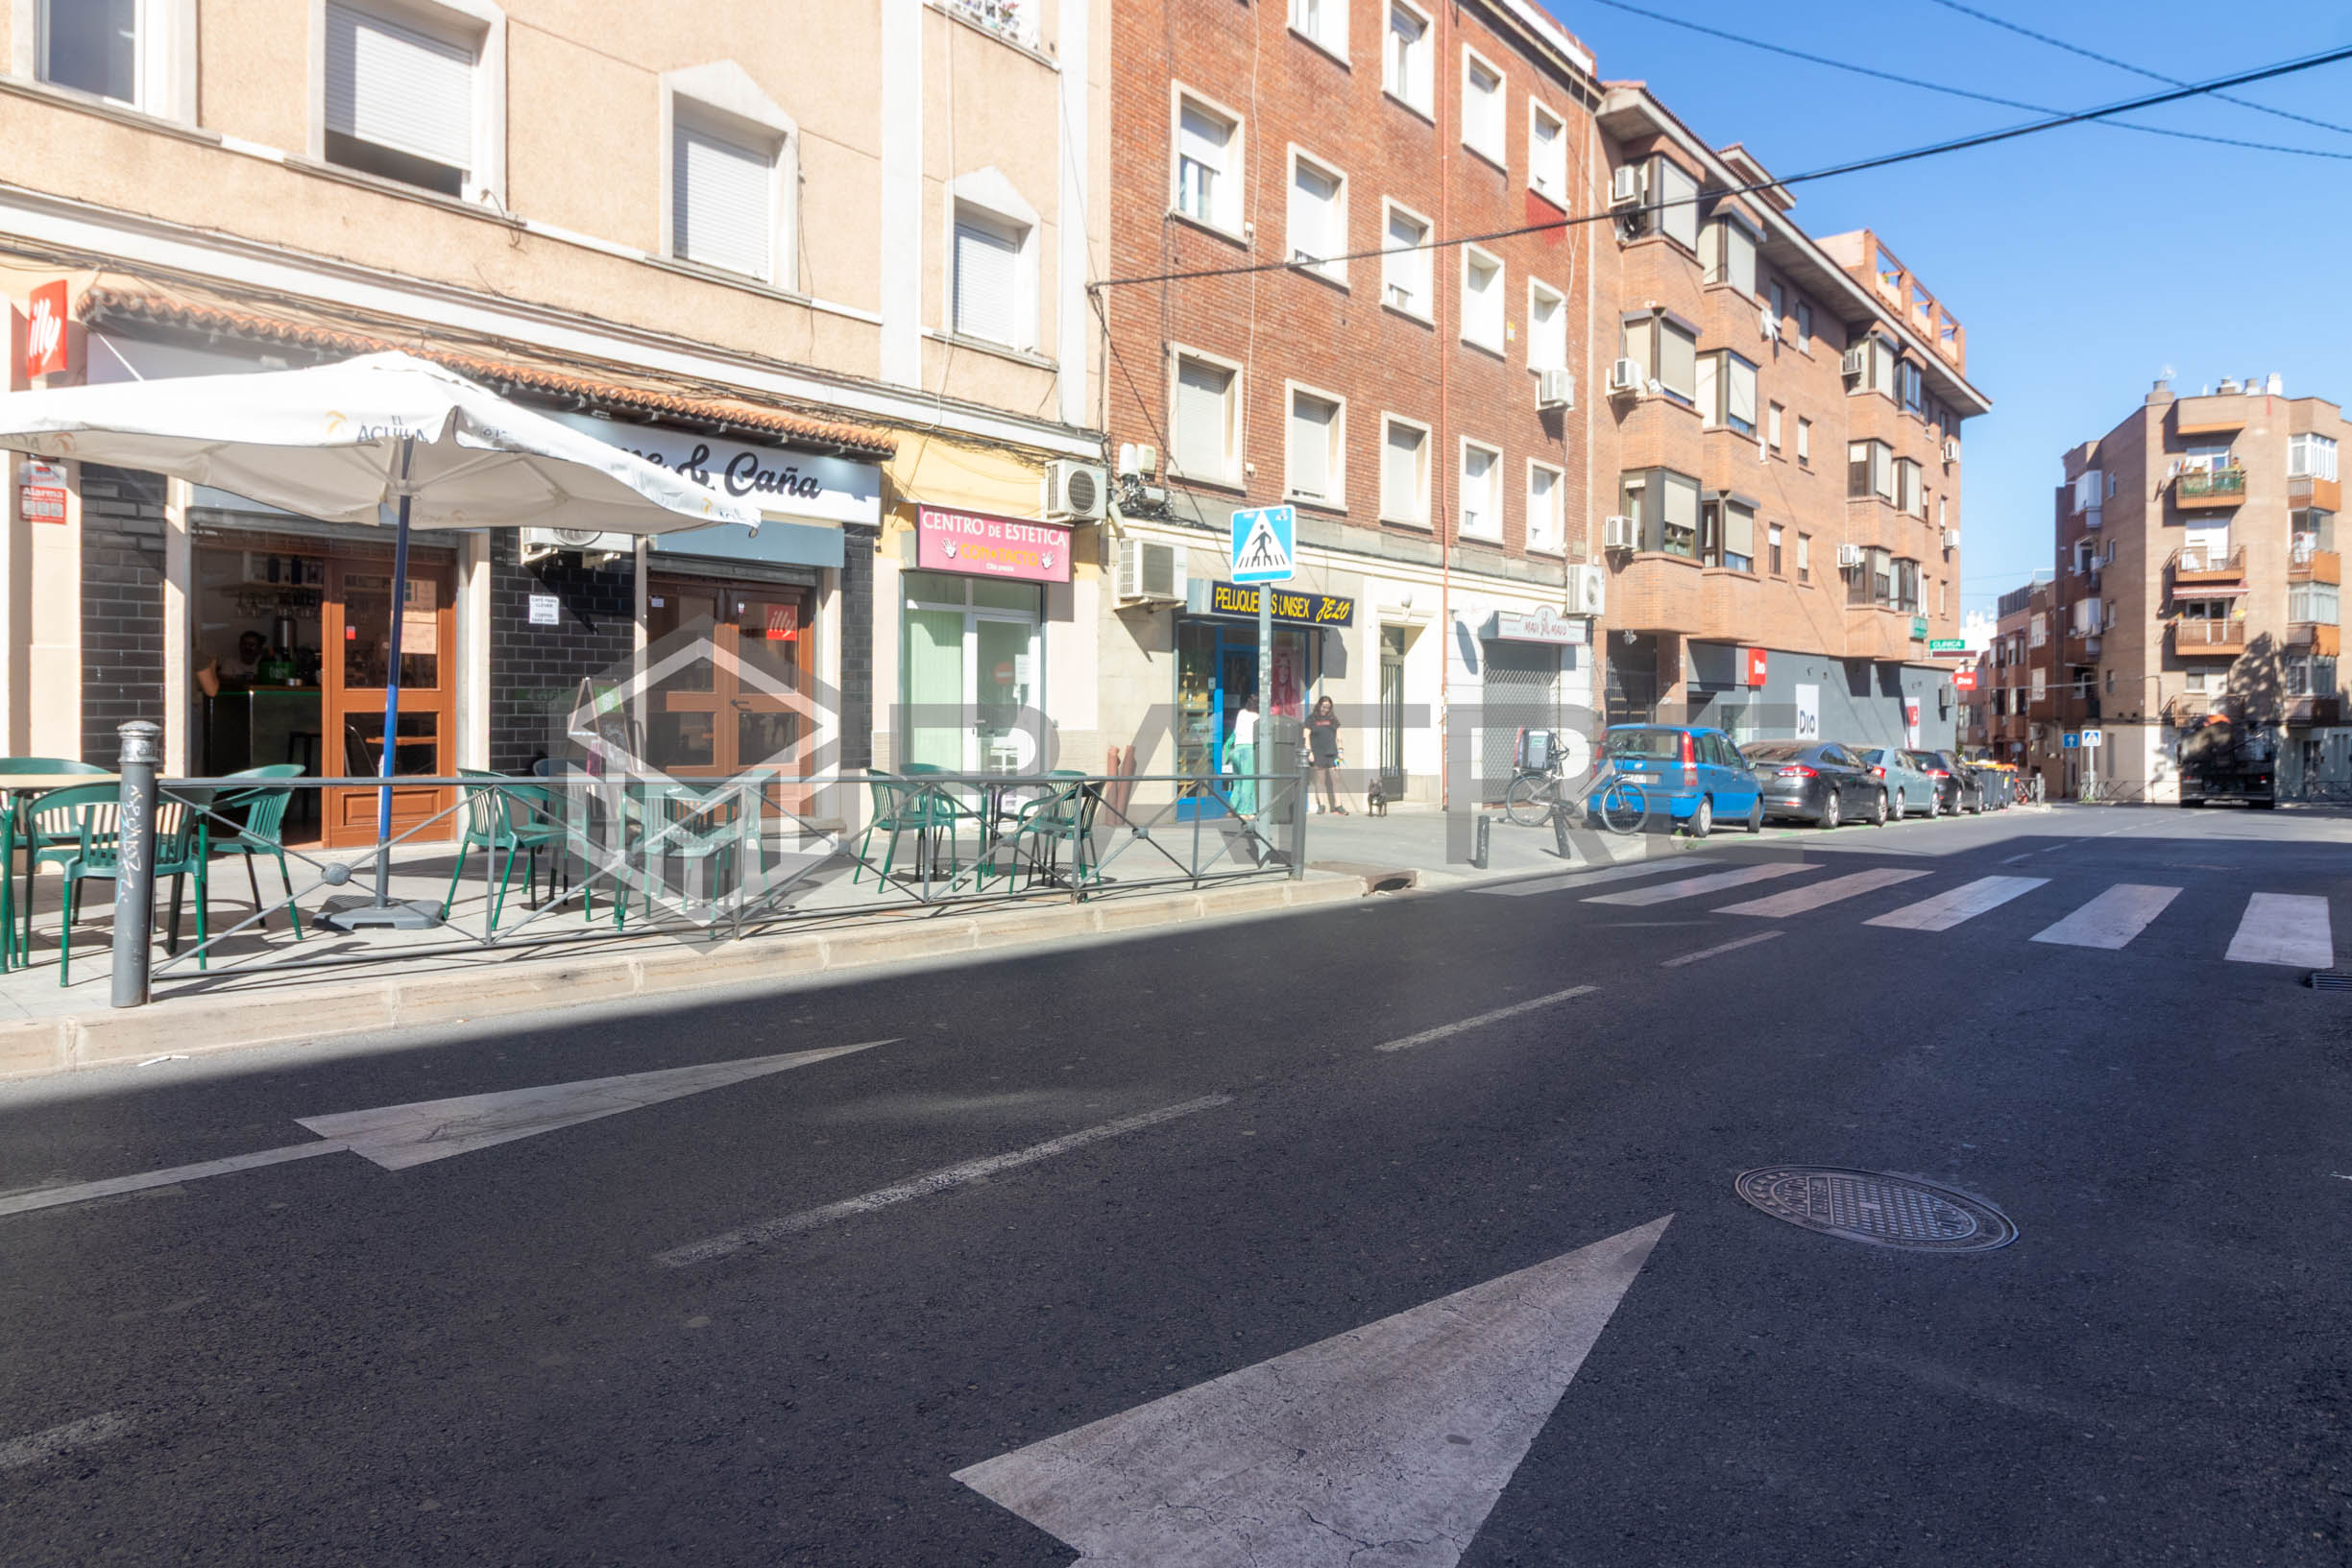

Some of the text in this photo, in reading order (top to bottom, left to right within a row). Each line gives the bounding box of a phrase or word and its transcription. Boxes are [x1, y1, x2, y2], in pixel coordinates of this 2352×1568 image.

[29, 298, 61, 367] illy
[724, 451, 823, 499] Caña
[23, 487, 63, 498] Alarma
[922, 511, 984, 536] CENTRO
[988, 524, 1002, 539] DE
[1215, 587, 1277, 615] PELUQUES
[1279, 594, 1310, 618] UNISEX
[768, 610, 796, 639] illy
